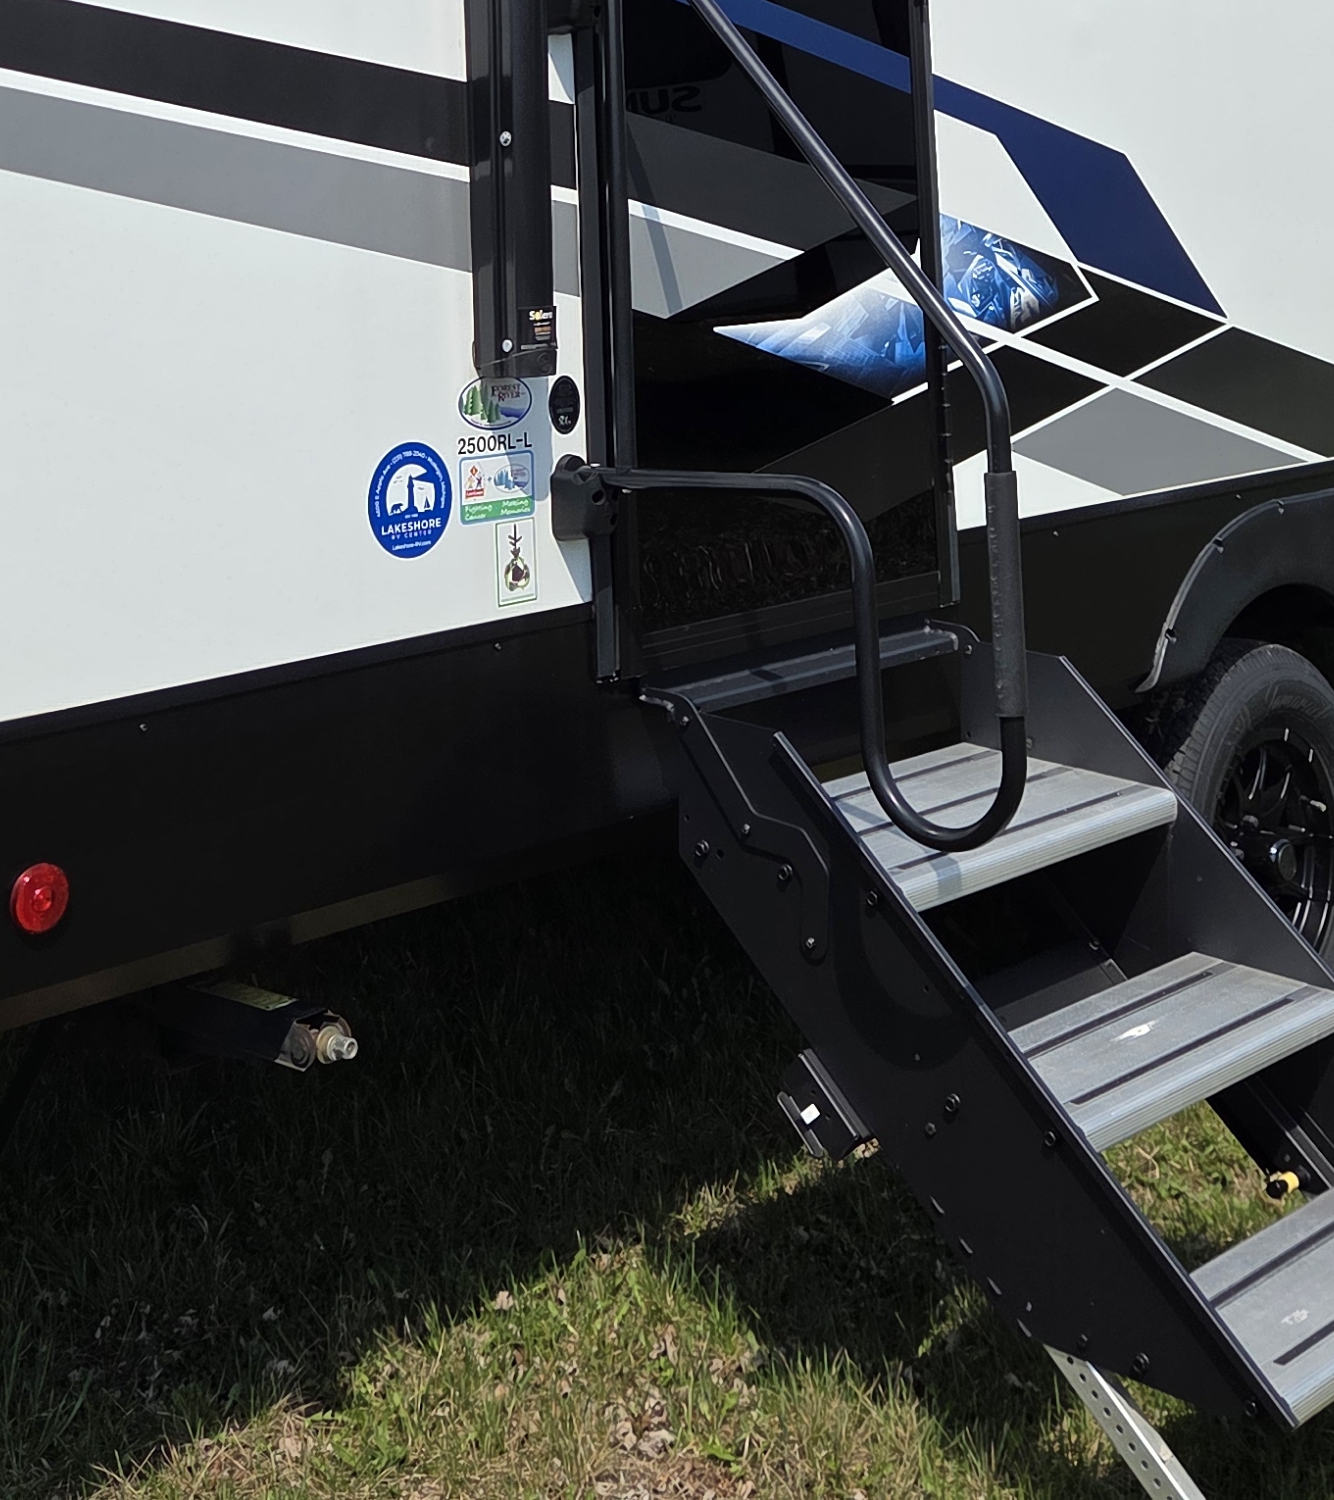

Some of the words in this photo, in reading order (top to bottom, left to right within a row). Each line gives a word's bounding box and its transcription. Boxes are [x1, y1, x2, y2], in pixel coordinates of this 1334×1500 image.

[491, 383, 521, 397] FOREST
[498, 392, 521, 402] RIVER
[457, 432, 532, 455] 2500RL-L
[381, 518, 442, 536] LAKESHORE
